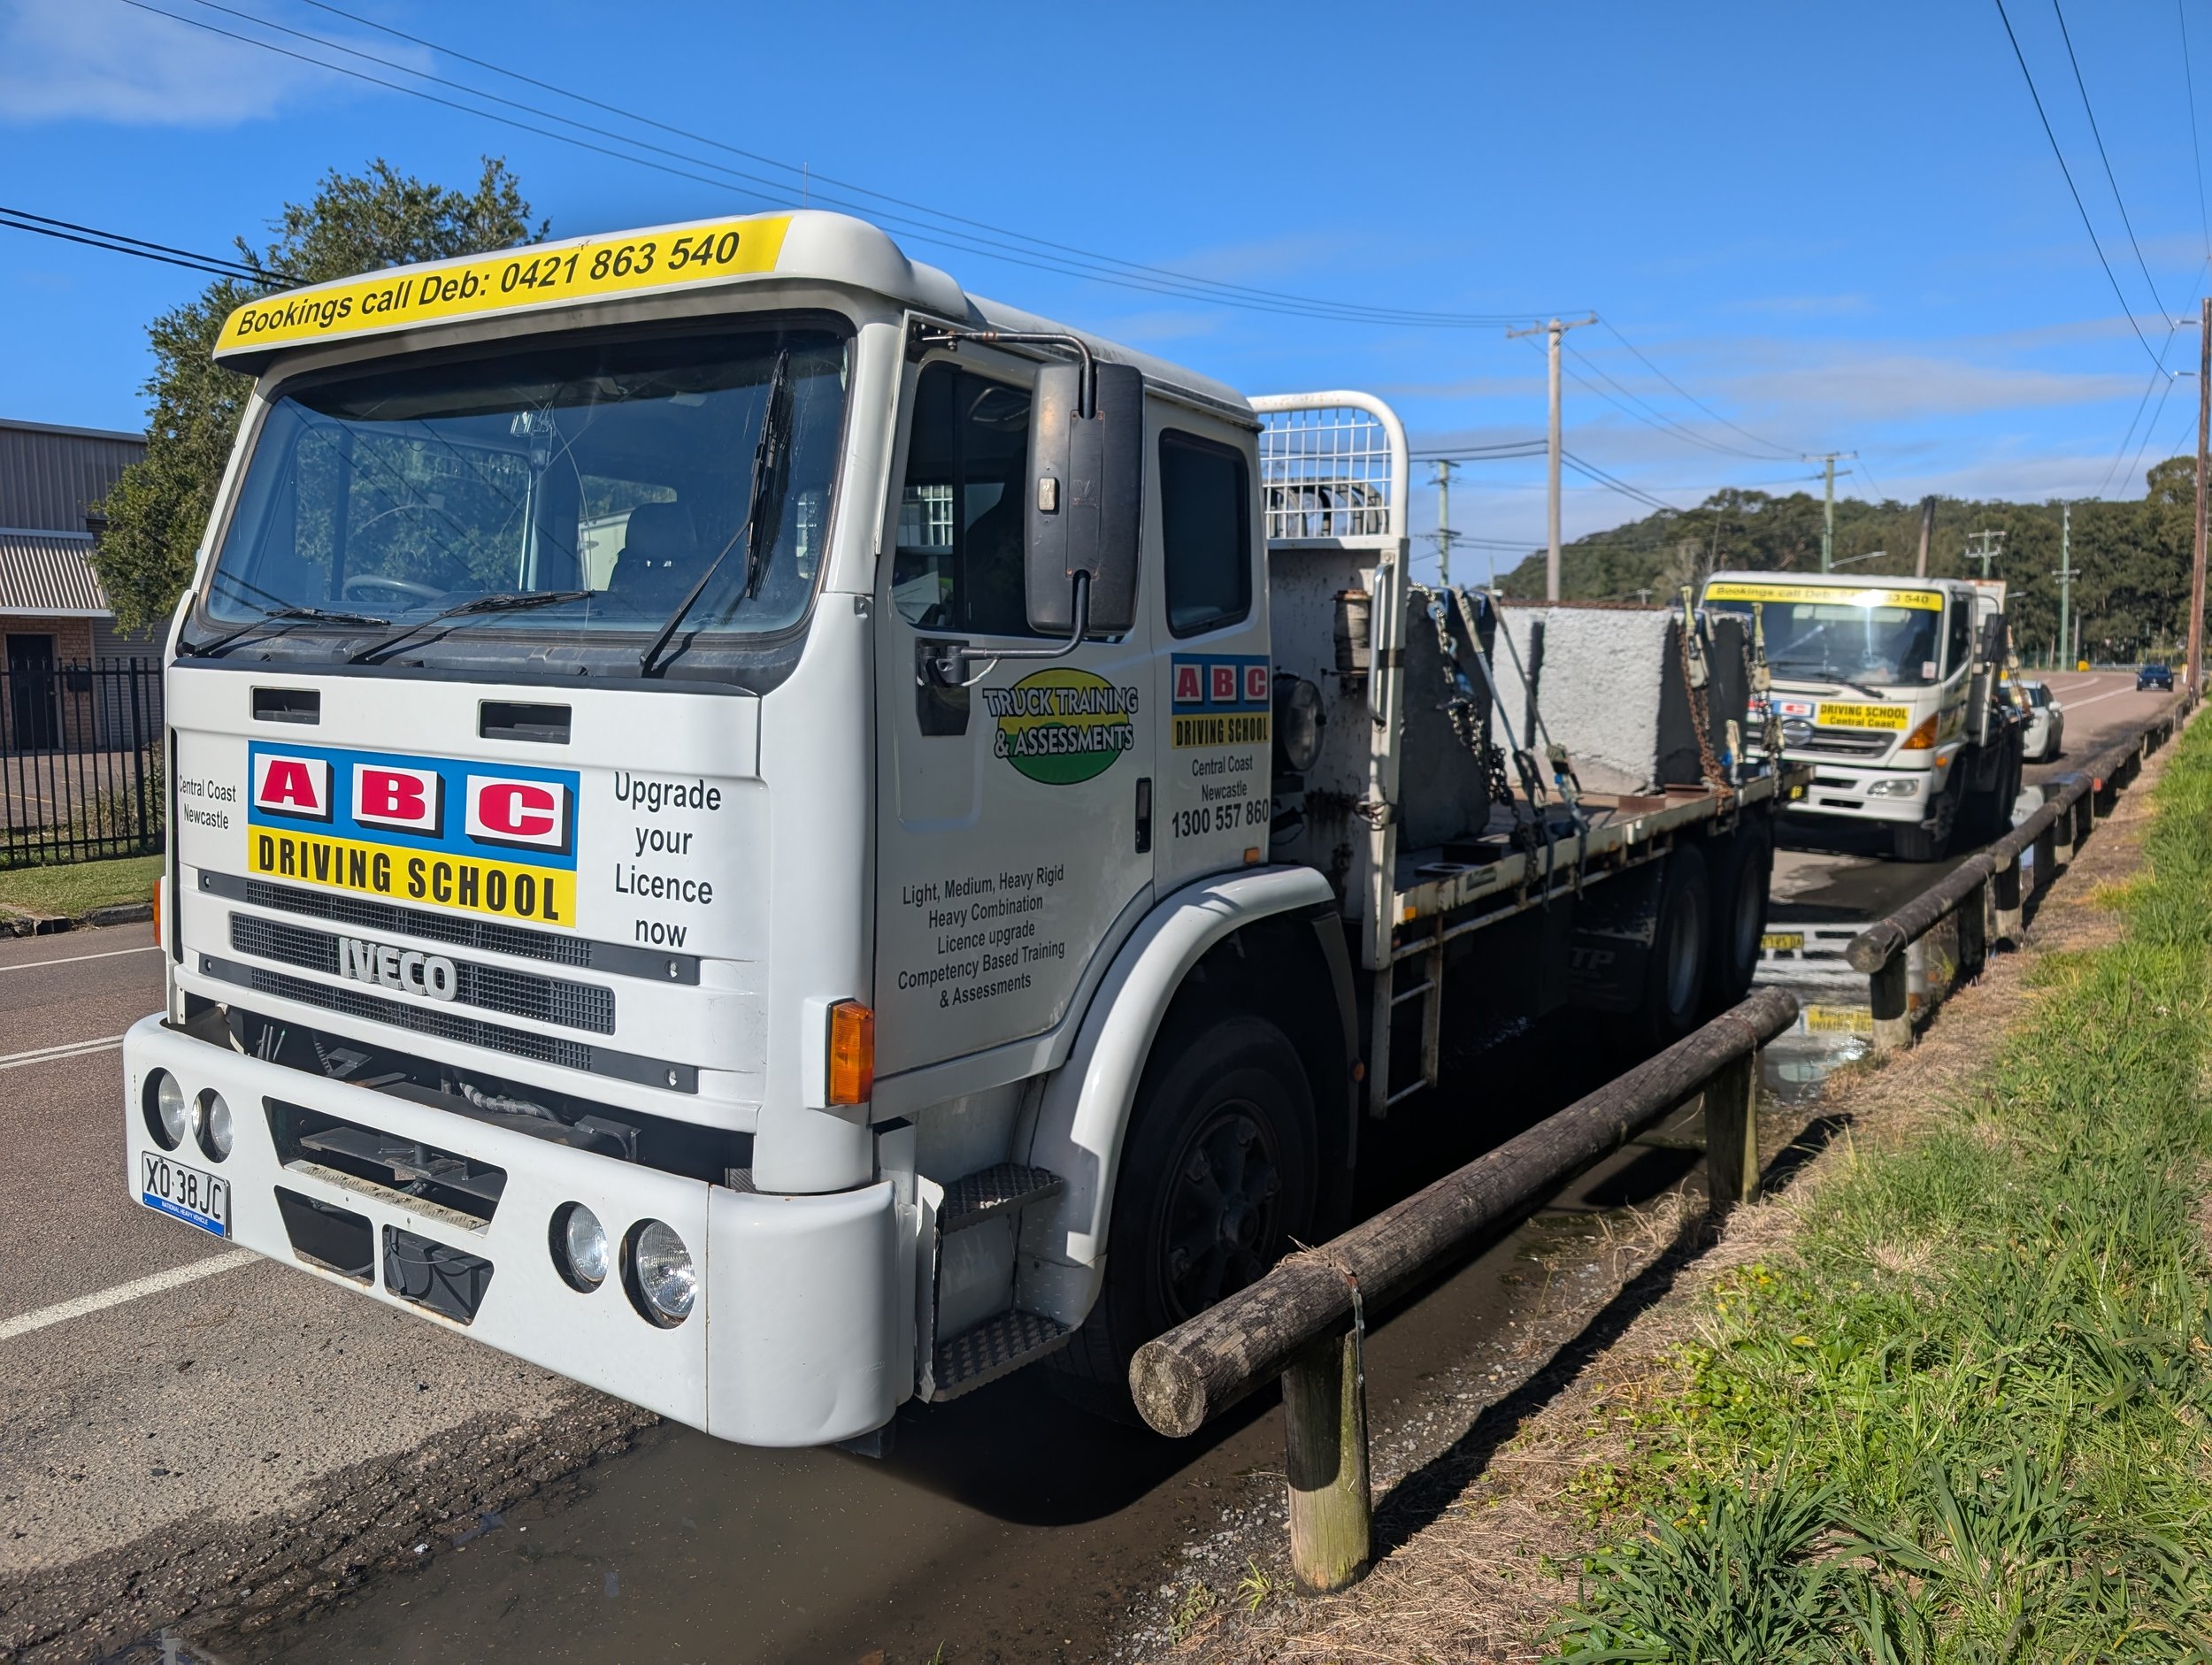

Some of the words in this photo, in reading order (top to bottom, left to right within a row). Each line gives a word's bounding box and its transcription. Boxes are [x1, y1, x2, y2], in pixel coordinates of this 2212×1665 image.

[236, 297, 352, 337] Bookings
[361, 280, 410, 315] call
[419, 270, 490, 306] Deb:
[501, 251, 579, 294] 0421
[589, 242, 656, 280] 863
[666, 231, 741, 271] 540
[1716, 586, 1774, 598] Bookings
[982, 687, 1055, 717] TRUCK
[1055, 687, 1139, 716] TRAINING
[1820, 702, 1863, 717] DRIVING
[1865, 705, 1908, 720] SCHOOL
[1176, 717, 1225, 747] DRIVING
[1228, 717, 1268, 743] SCHOOL
[1829, 716, 1864, 726] Central
[1867, 718, 1895, 729] Coast
[994, 727, 1010, 758] &
[1013, 723, 1134, 757] ASSESSMENTS
[1192, 756, 1226, 777] Central
[1228, 754, 1254, 772] Coast
[179, 773, 204, 797] Central
[207, 779, 236, 802] Coast
[615, 771, 722, 813] Upgrade
[1202, 779, 1248, 802] Newcastle
[183, 802, 229, 830] Newcastle
[1171, 807, 1210, 839] 1300
[1215, 802, 1242, 832] 557
[1246, 798, 1269, 826] 860
[634, 826, 694, 857] your
[258, 834, 392, 894] DRIVING
[407, 856, 560, 921] SCHOOL
[615, 863, 713, 905] Licence
[902, 883, 941, 908] Light,
[944, 877, 996, 900] Medium,
[999, 871, 1033, 891] Heavy
[1036, 863, 1064, 887] Rigid
[928, 908, 968, 929] Heavy
[971, 894, 1043, 921] Combination
[634, 918, 687, 948] now
[937, 932, 986, 955] Licence
[988, 919, 1035, 948] upgrade
[338, 936, 458, 1002] IVECO
[898, 959, 979, 991] Competency
[982, 948, 1018, 973] Based
[1021, 940, 1065, 964] Training
[940, 989, 949, 1009] &
[952, 972, 1032, 1006] Assessments
